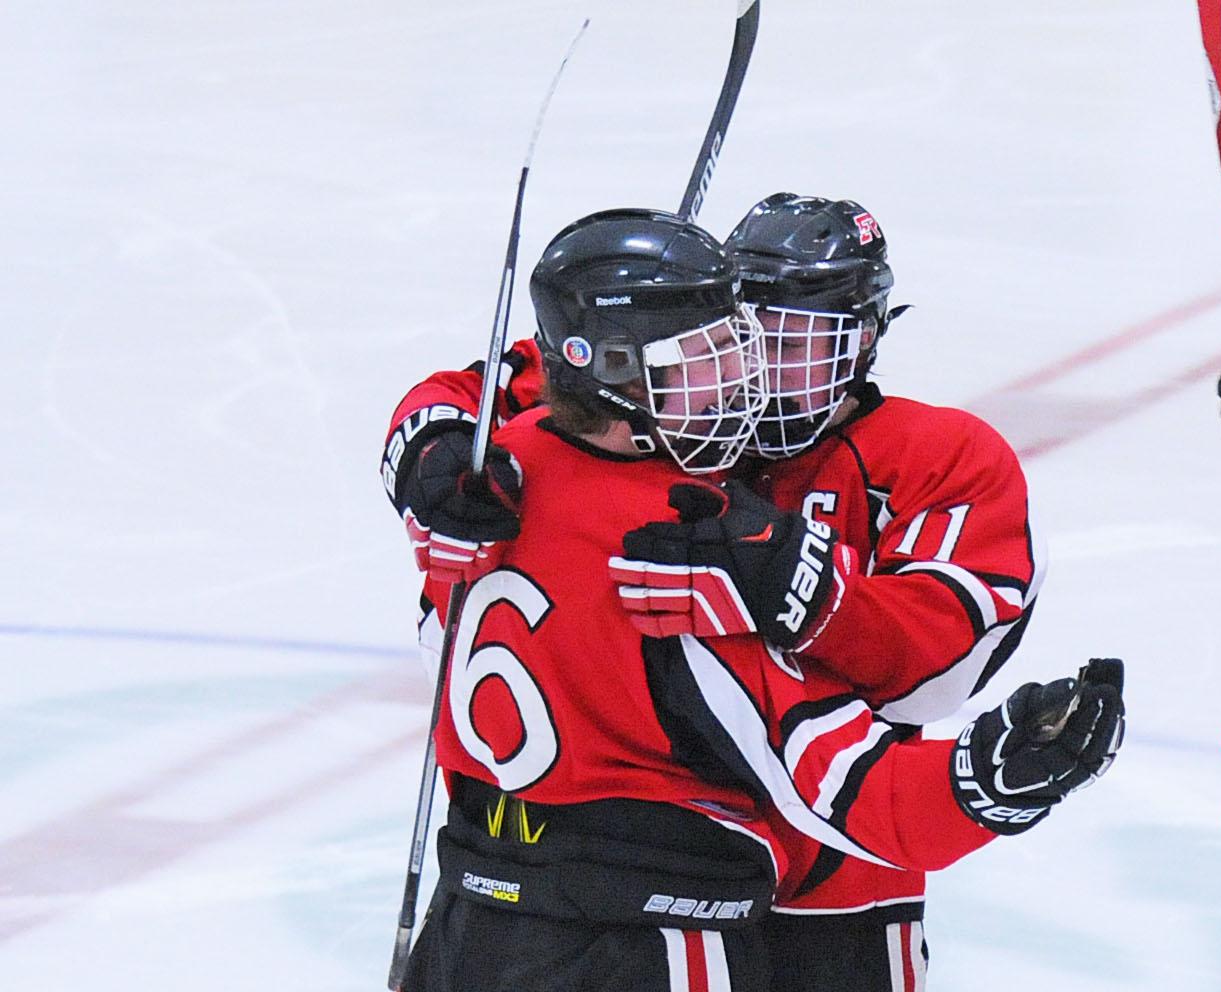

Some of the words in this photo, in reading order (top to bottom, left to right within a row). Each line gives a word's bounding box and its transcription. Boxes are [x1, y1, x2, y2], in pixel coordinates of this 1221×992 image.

[688, 131, 722, 223] eme
[596, 296, 632, 306] Reebok
[598, 389, 637, 410] CCM
[895, 503, 971, 562] 11
[775, 519, 832, 634] AUER
[449, 569, 559, 793] 6
[642, 894, 755, 920] BAUER
